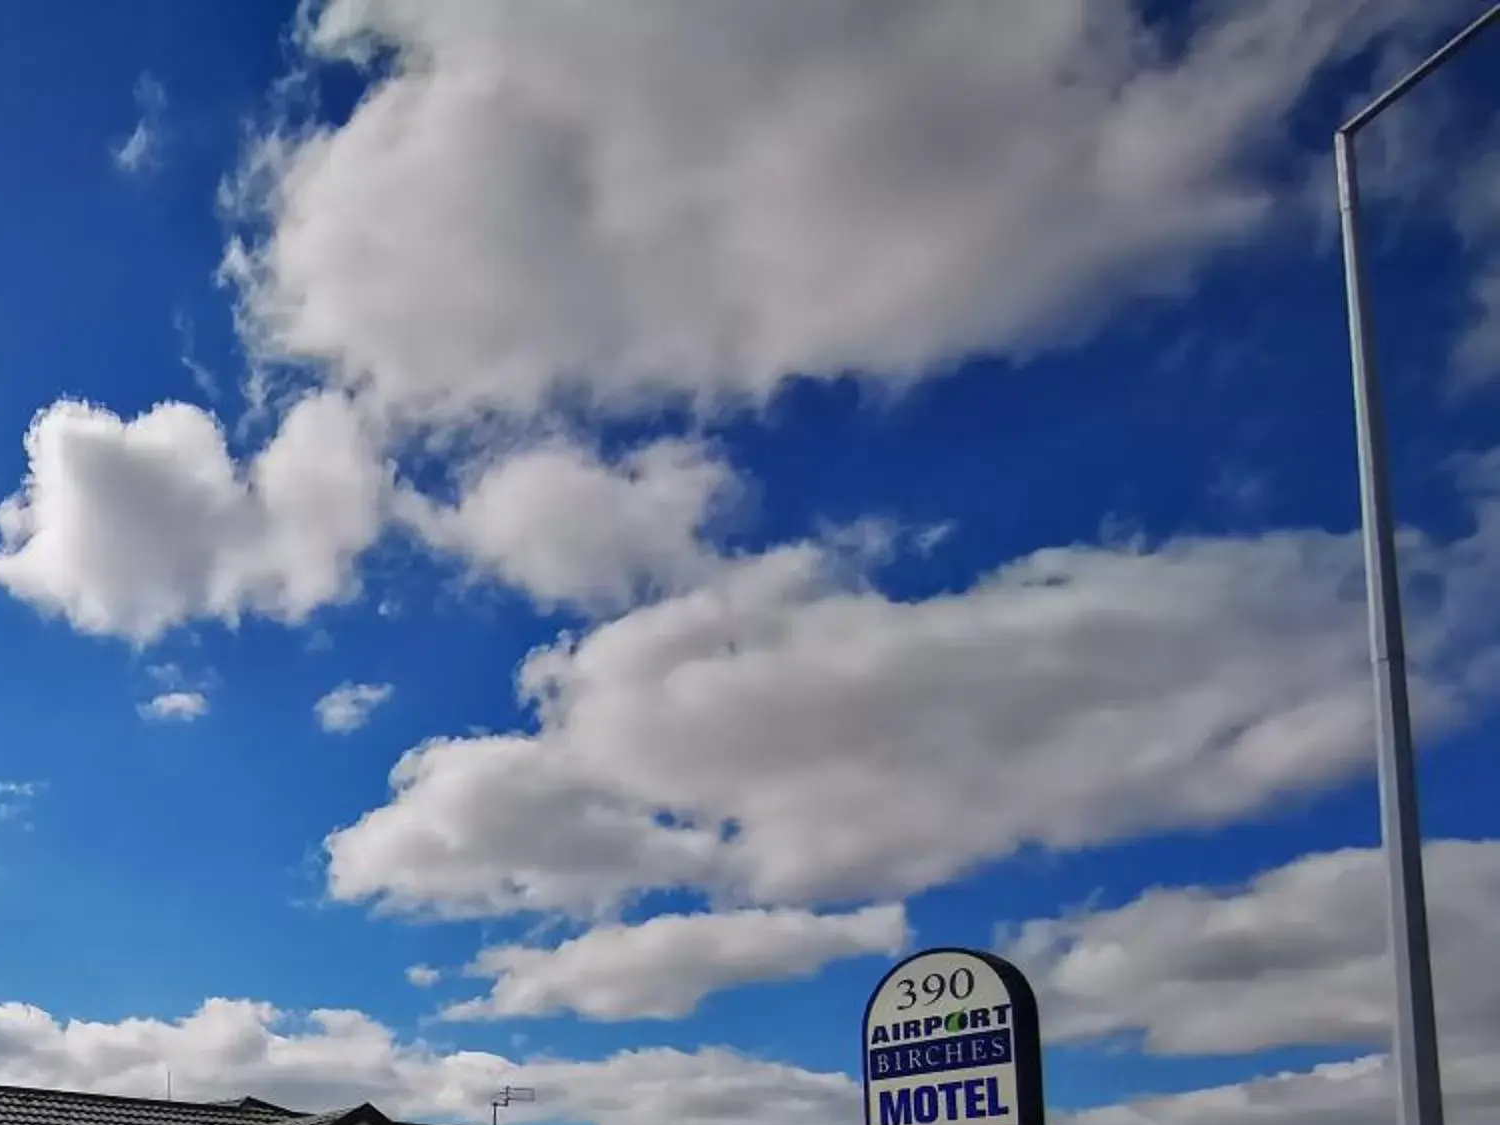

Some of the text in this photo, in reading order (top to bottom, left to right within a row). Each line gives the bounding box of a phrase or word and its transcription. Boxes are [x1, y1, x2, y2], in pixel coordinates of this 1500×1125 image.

[896, 967, 975, 1010] 390
[871, 1003, 1011, 1044] AIRPORT
[877, 1036, 1005, 1073] BIRCHES
